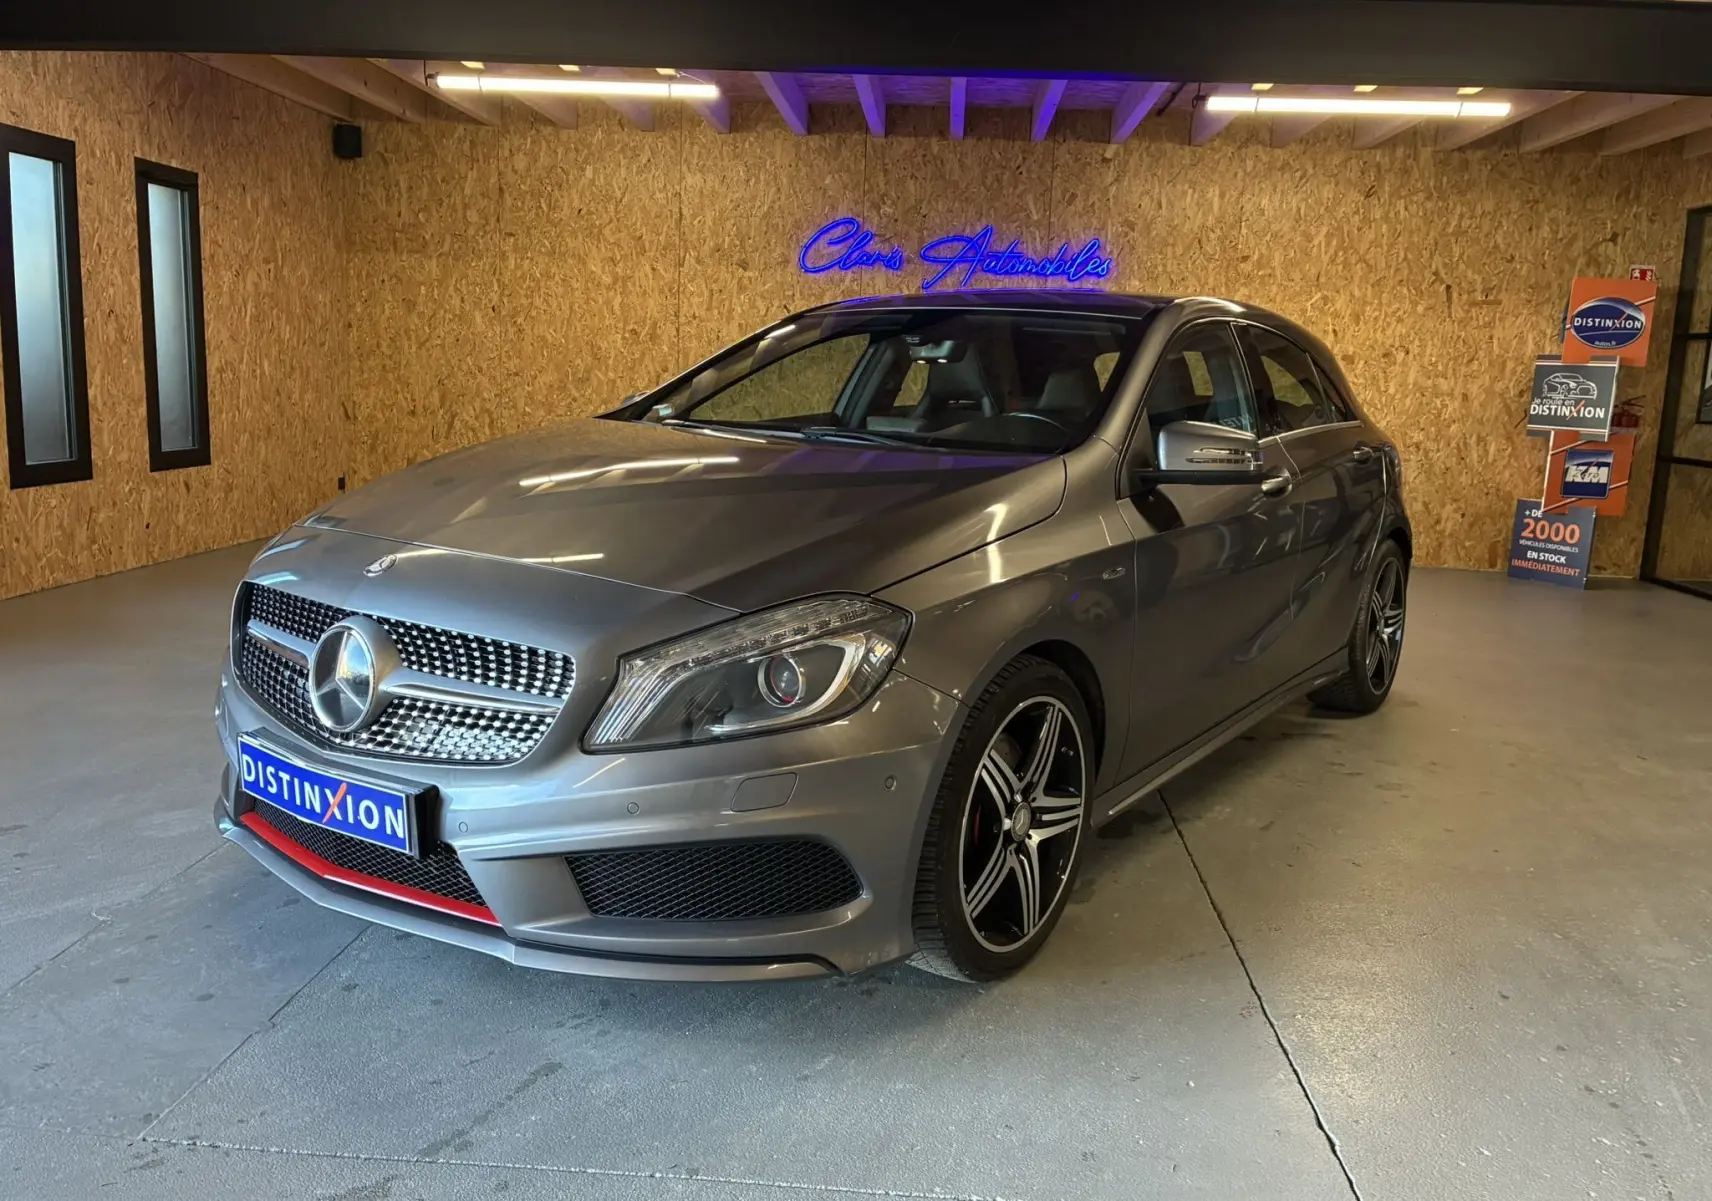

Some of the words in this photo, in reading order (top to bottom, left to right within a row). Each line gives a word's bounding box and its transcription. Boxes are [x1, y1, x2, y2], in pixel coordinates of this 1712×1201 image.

[799, 217, 903, 273] Claris
[919, 224, 1113, 290] Automobiles
[1574, 313, 1642, 330] DISTINXION
[1530, 401, 1605, 420] DISTINXION
[1543, 398, 1563, 406] roule
[1564, 465, 1609, 483] KM
[1531, 509, 1543, 517] DE
[1520, 518, 1580, 544] 2000
[1545, 543, 1579, 553] DISPONIBLES
[1526, 550, 1538, 560] EN
[1538, 552, 1567, 564] STOCK
[1511, 559, 1580, 576] IMMÉDIATEMENT
[240, 752, 405, 839] DISTINXION
